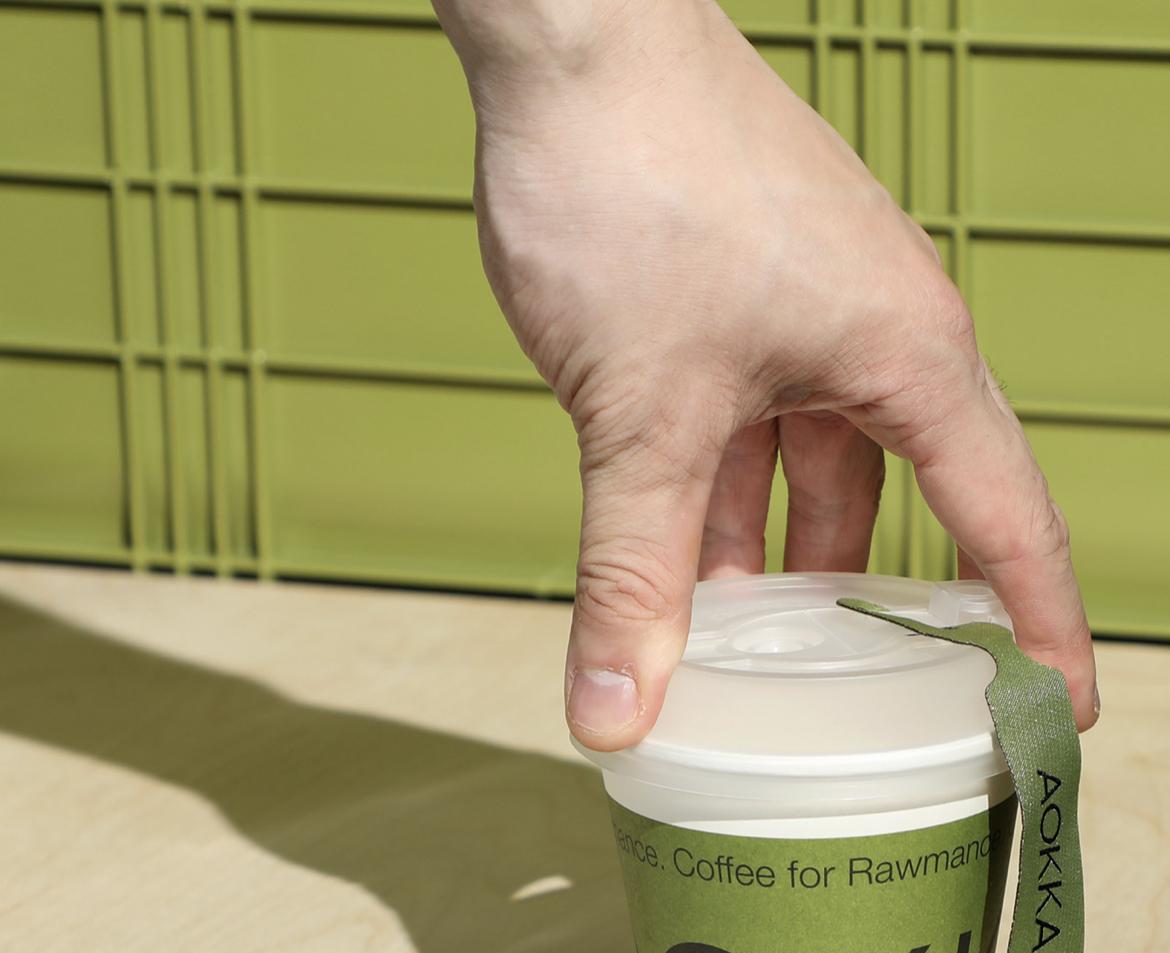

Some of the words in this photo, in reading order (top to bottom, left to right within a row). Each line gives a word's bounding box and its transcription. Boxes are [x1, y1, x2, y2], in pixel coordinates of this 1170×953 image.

[616, 828, 665, 871] ance.
[673, 847, 776, 888] Coffee
[787, 859, 836, 888] for
[1031, 769, 1063, 953] AOKKA
